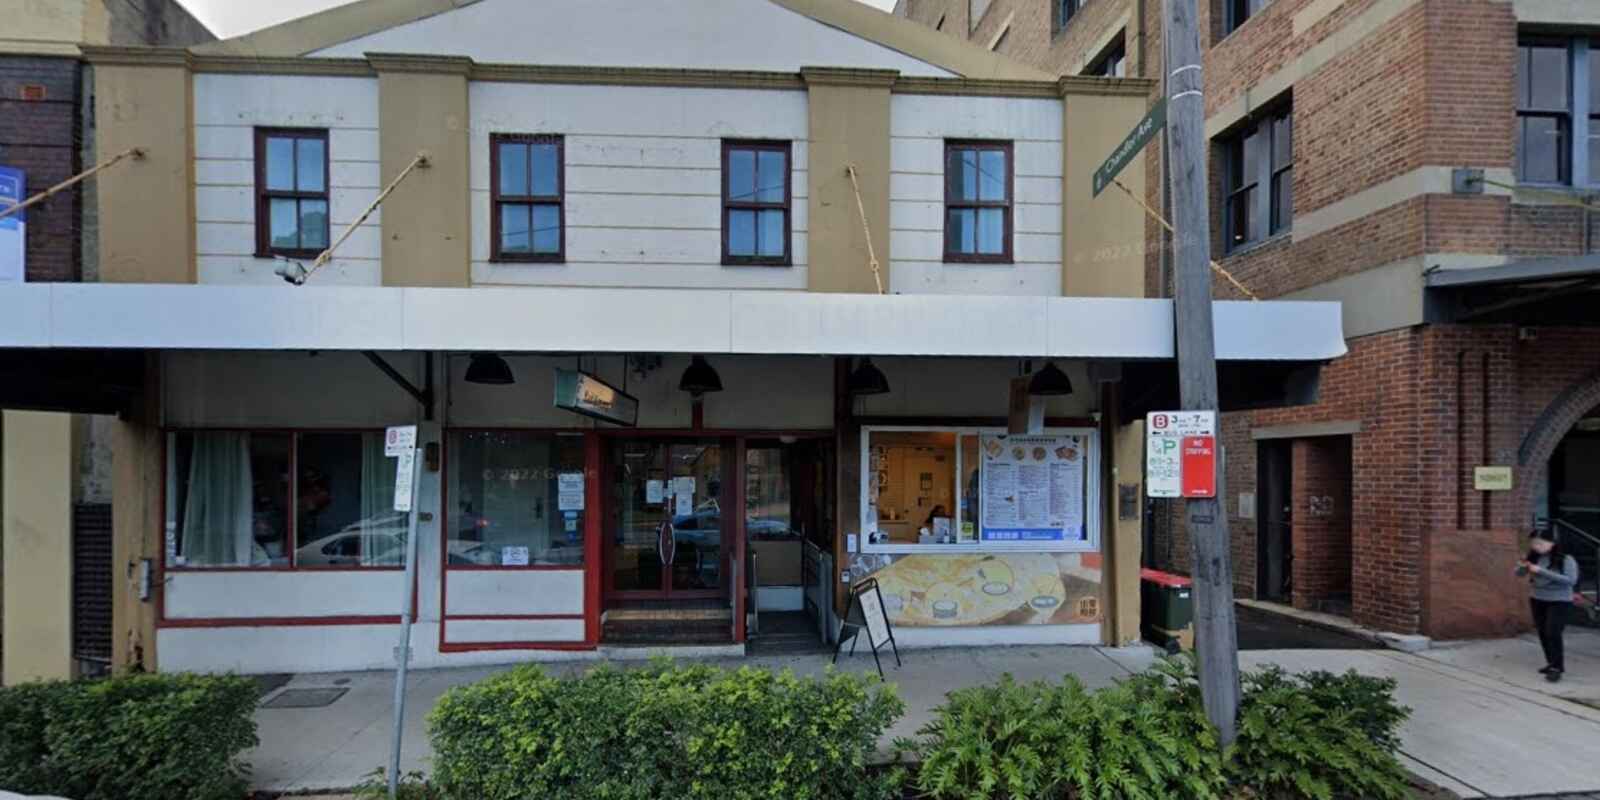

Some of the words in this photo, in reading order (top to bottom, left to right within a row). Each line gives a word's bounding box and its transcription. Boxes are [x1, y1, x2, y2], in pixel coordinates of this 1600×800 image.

[1105, 136, 1138, 174] Chandler
[1138, 117, 1153, 137] Ave
[1155, 415, 1168, 428] B
